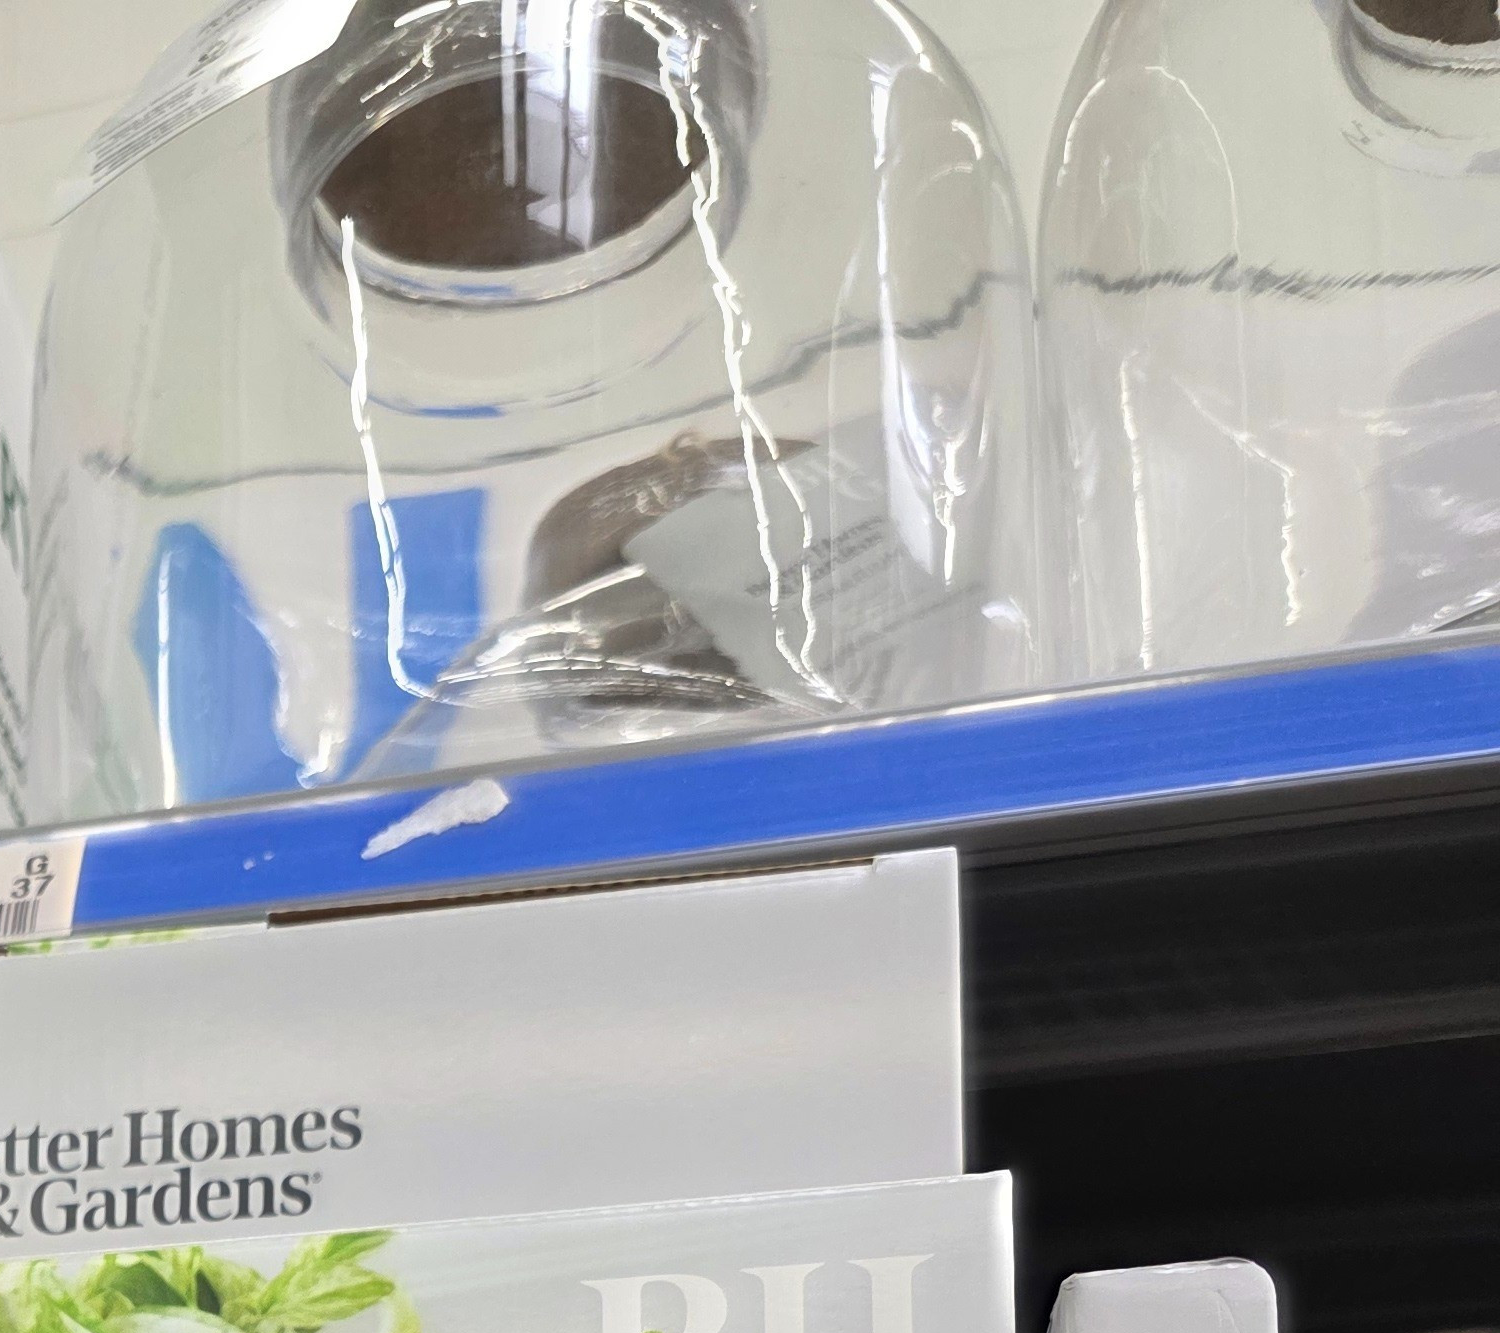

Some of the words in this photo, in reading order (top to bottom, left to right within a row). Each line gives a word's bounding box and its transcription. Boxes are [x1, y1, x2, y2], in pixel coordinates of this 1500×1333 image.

[25, 855, 49, 876] G
[11, 875, 55, 899] 37
[124, 1106, 363, 1169] Homes
